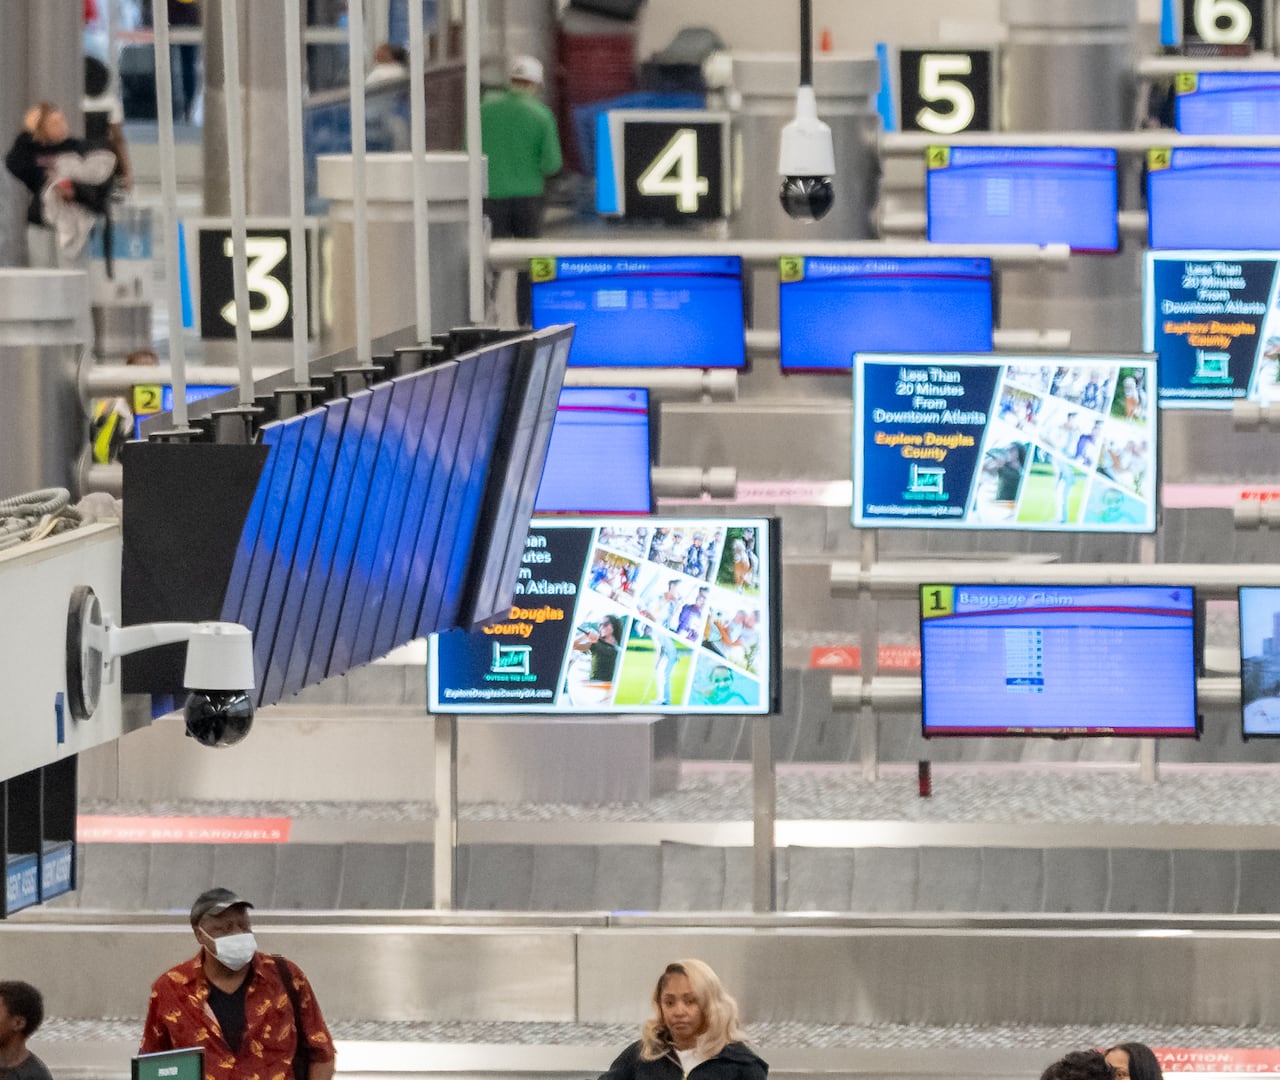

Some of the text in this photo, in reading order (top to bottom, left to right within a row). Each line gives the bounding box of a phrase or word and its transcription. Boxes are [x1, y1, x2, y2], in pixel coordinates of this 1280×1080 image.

[916, 55, 974, 132] 5
[637, 129, 709, 213] 4
[223, 236, 290, 332] 3
[142, 391, 156, 409] 2
[873, 410, 940, 424] Downtown
[875, 432, 974, 449] Explore Douglas
[901, 446, 947, 461] County
[527, 580, 577, 596] Atlanta
[930, 590, 1073, 611] 1 Baggage Claim
[508, 605, 565, 623] Douglas
[1163, 1063, 1215, 1073] LEASE
[1222, 1063, 1268, 1073] KEEP
